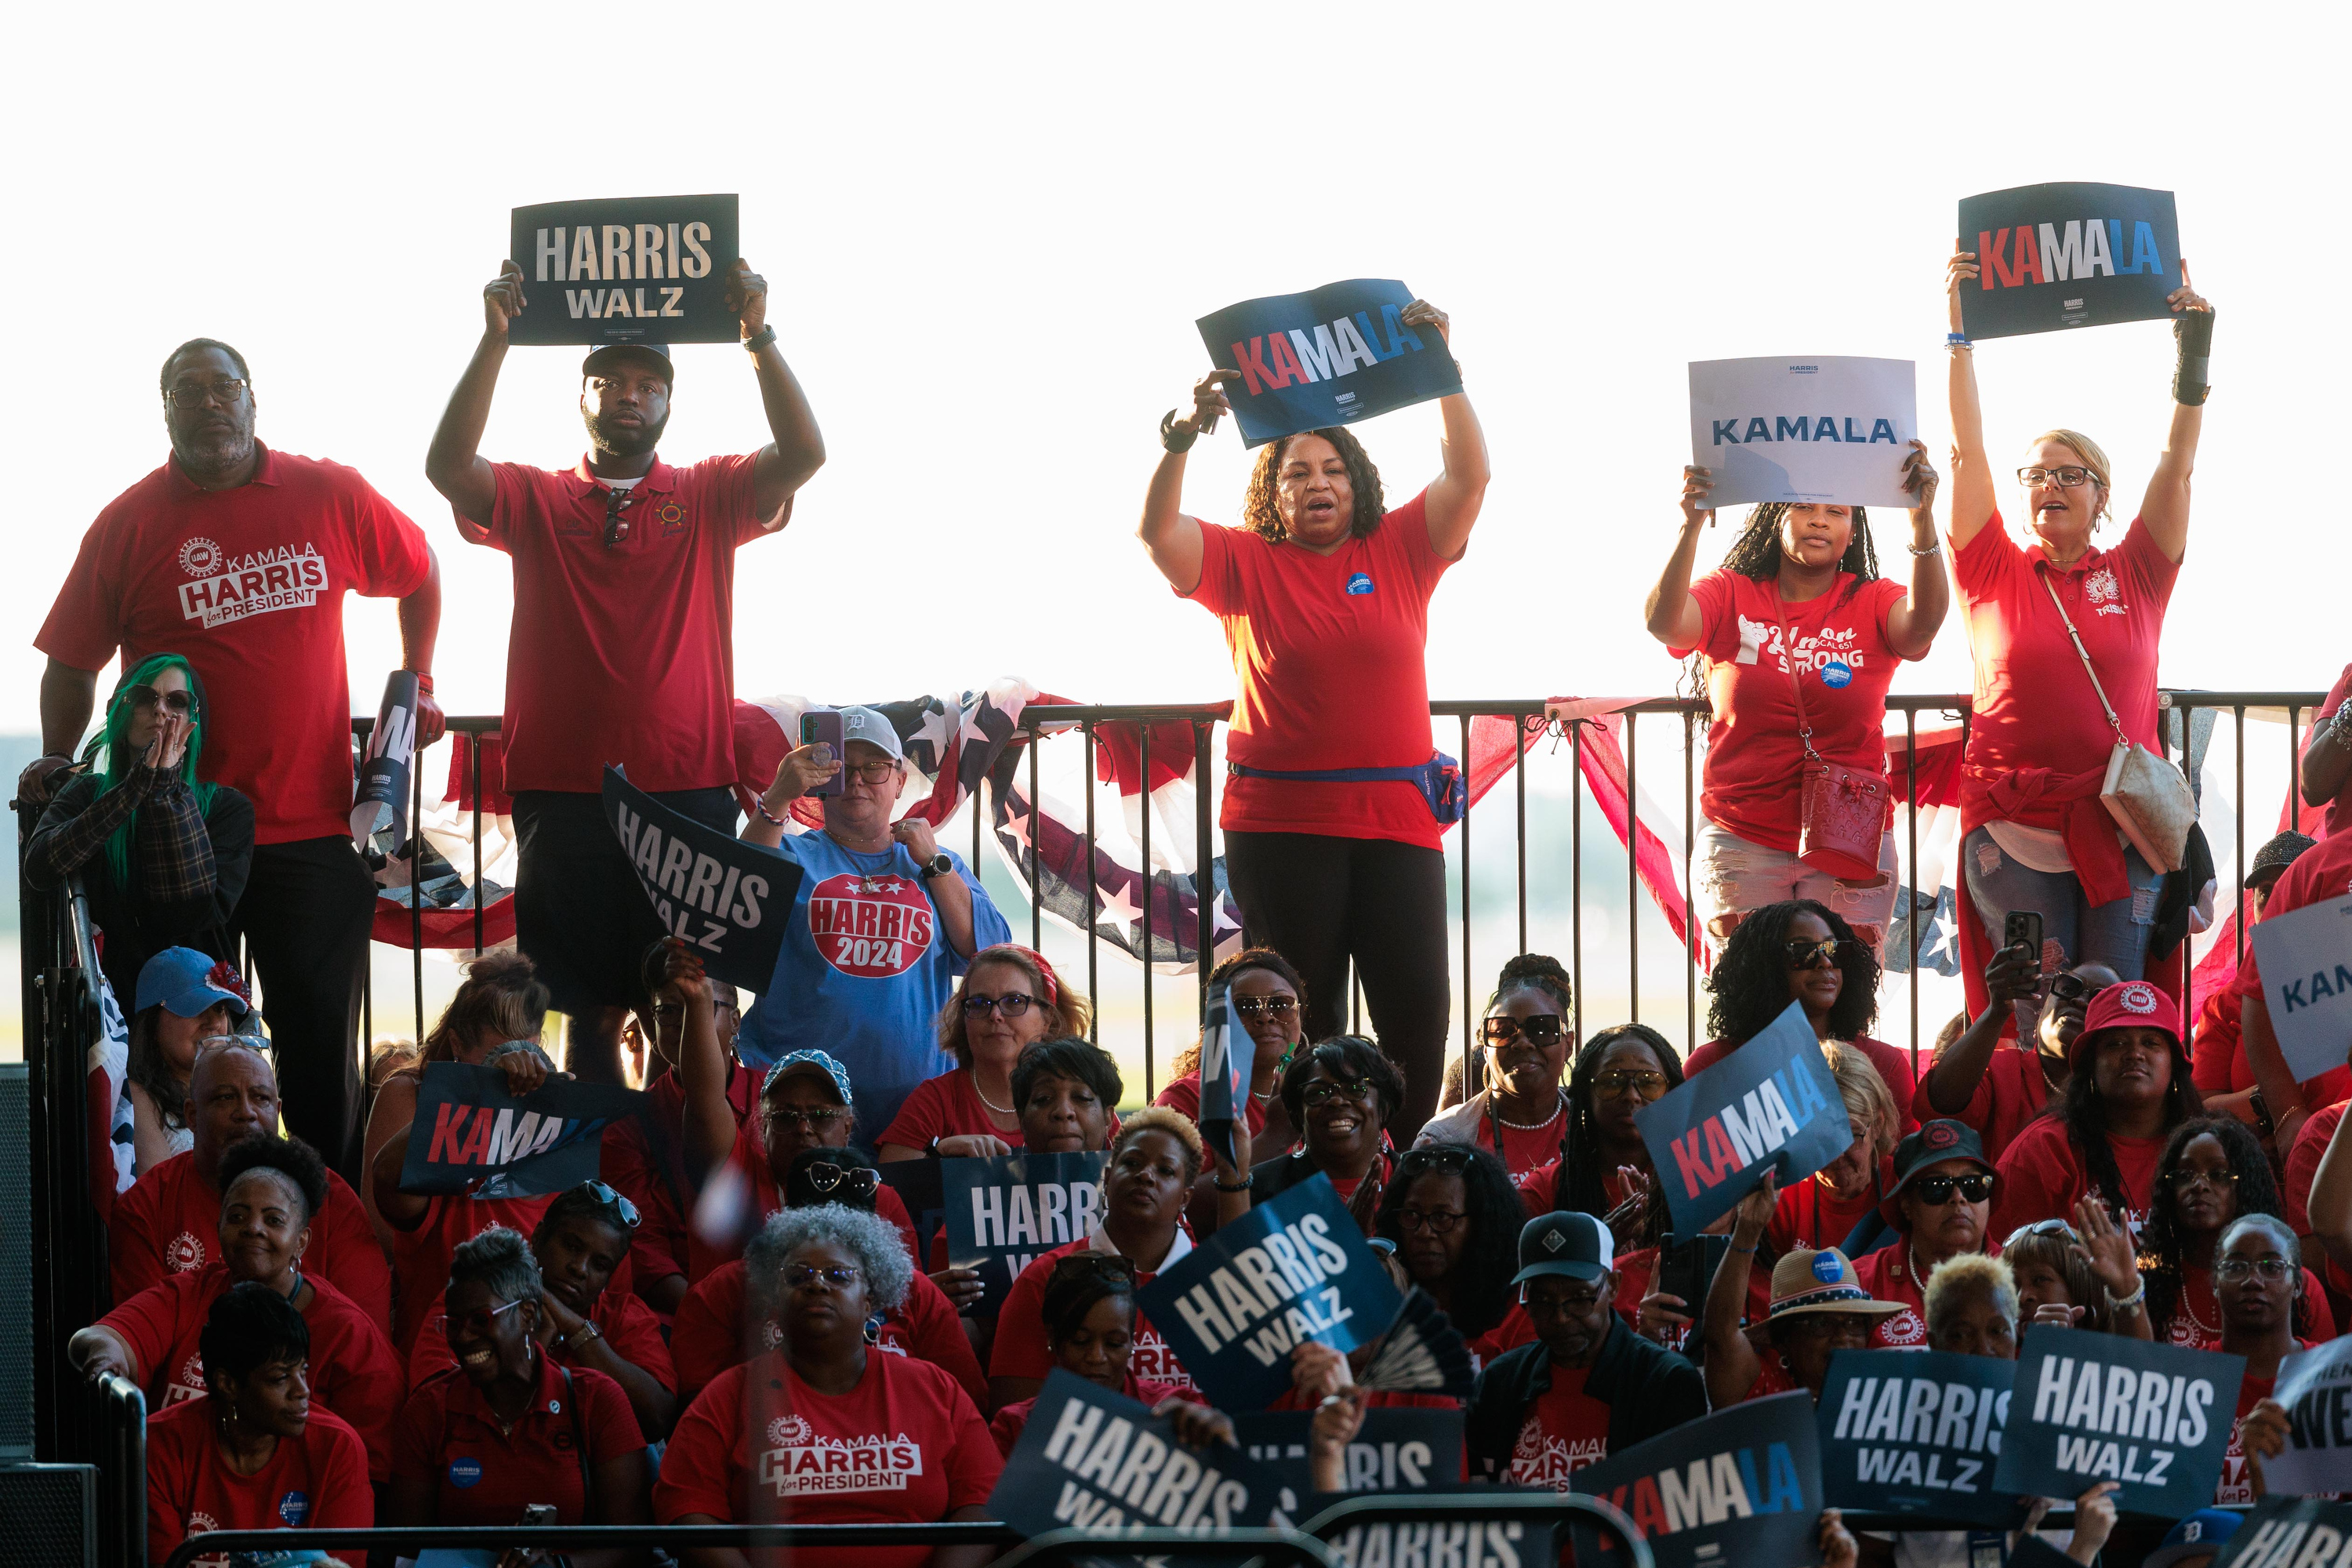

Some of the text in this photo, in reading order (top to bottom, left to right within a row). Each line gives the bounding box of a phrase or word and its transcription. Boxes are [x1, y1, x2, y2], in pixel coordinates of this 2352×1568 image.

[536, 221, 712, 282] HARRIS
[1979, 219, 2164, 291] KAMALA
[565, 286, 684, 319] WALZ
[2063, 298, 2084, 307] HARRIS
[1231, 303, 1425, 396] KAMALA
[1334, 391, 1356, 402] HARRIS
[1712, 416, 1898, 446] KAMALA
[191, 551, 209, 562] UAW
[226, 542, 318, 572] KAMALA
[185, 560, 323, 614] HARRIS
[206, 589, 314, 626] for PRESIDENT
[1838, 641, 1853, 650] 651
[1824, 667, 1850, 678] HARRIS
[372, 774, 391, 782] HARRIS
[618, 800, 769, 929] HARRIS
[811, 900, 932, 946] HARRIS
[836, 937, 902, 969] 2024
[2131, 995, 2148, 1004] UAW
[1669, 1053, 1828, 1200] KAMALA
[1173, 1213, 1348, 1356] HARRIS
[1243, 1285, 1354, 1367] WALZ
[1893, 1323, 1912, 1332] UAW
[2032, 1354, 2215, 1447] HARRIS
[780, 1425, 799, 1435] UAW
[814, 1432, 912, 1450] KAMALA
[766, 1446, 915, 1479] HARRIS
[1043, 1396, 1250, 1538] HARRIS
[1857, 1447, 1984, 1494] WALZ
[2056, 1434, 2175, 1486] WALZ
[781, 1471, 904, 1494] for PRESIDENT
